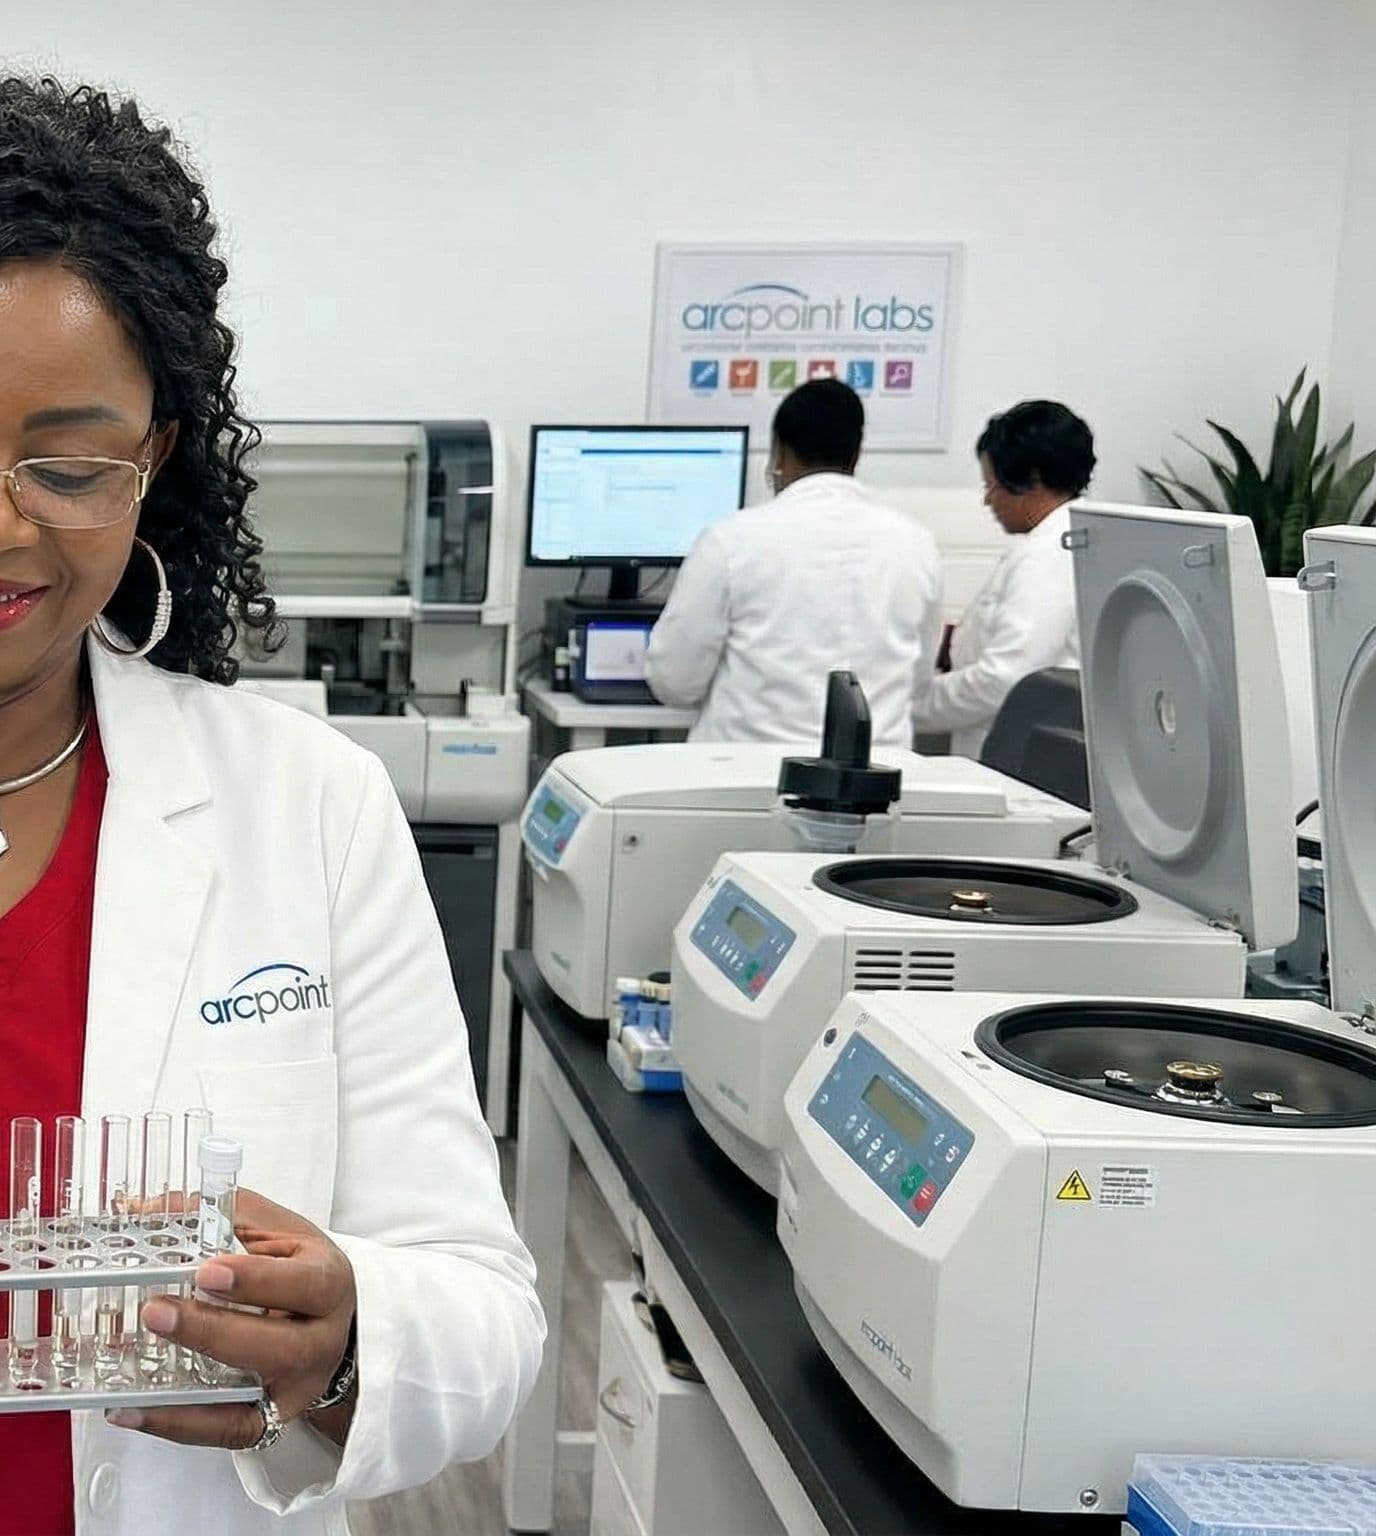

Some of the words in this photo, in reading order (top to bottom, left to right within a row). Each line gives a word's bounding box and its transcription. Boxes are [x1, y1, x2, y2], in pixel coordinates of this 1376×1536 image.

[681, 296, 844, 337] arcpoint
[853, 295, 935, 332] labs
[200, 974, 331, 1025] arcpoint
